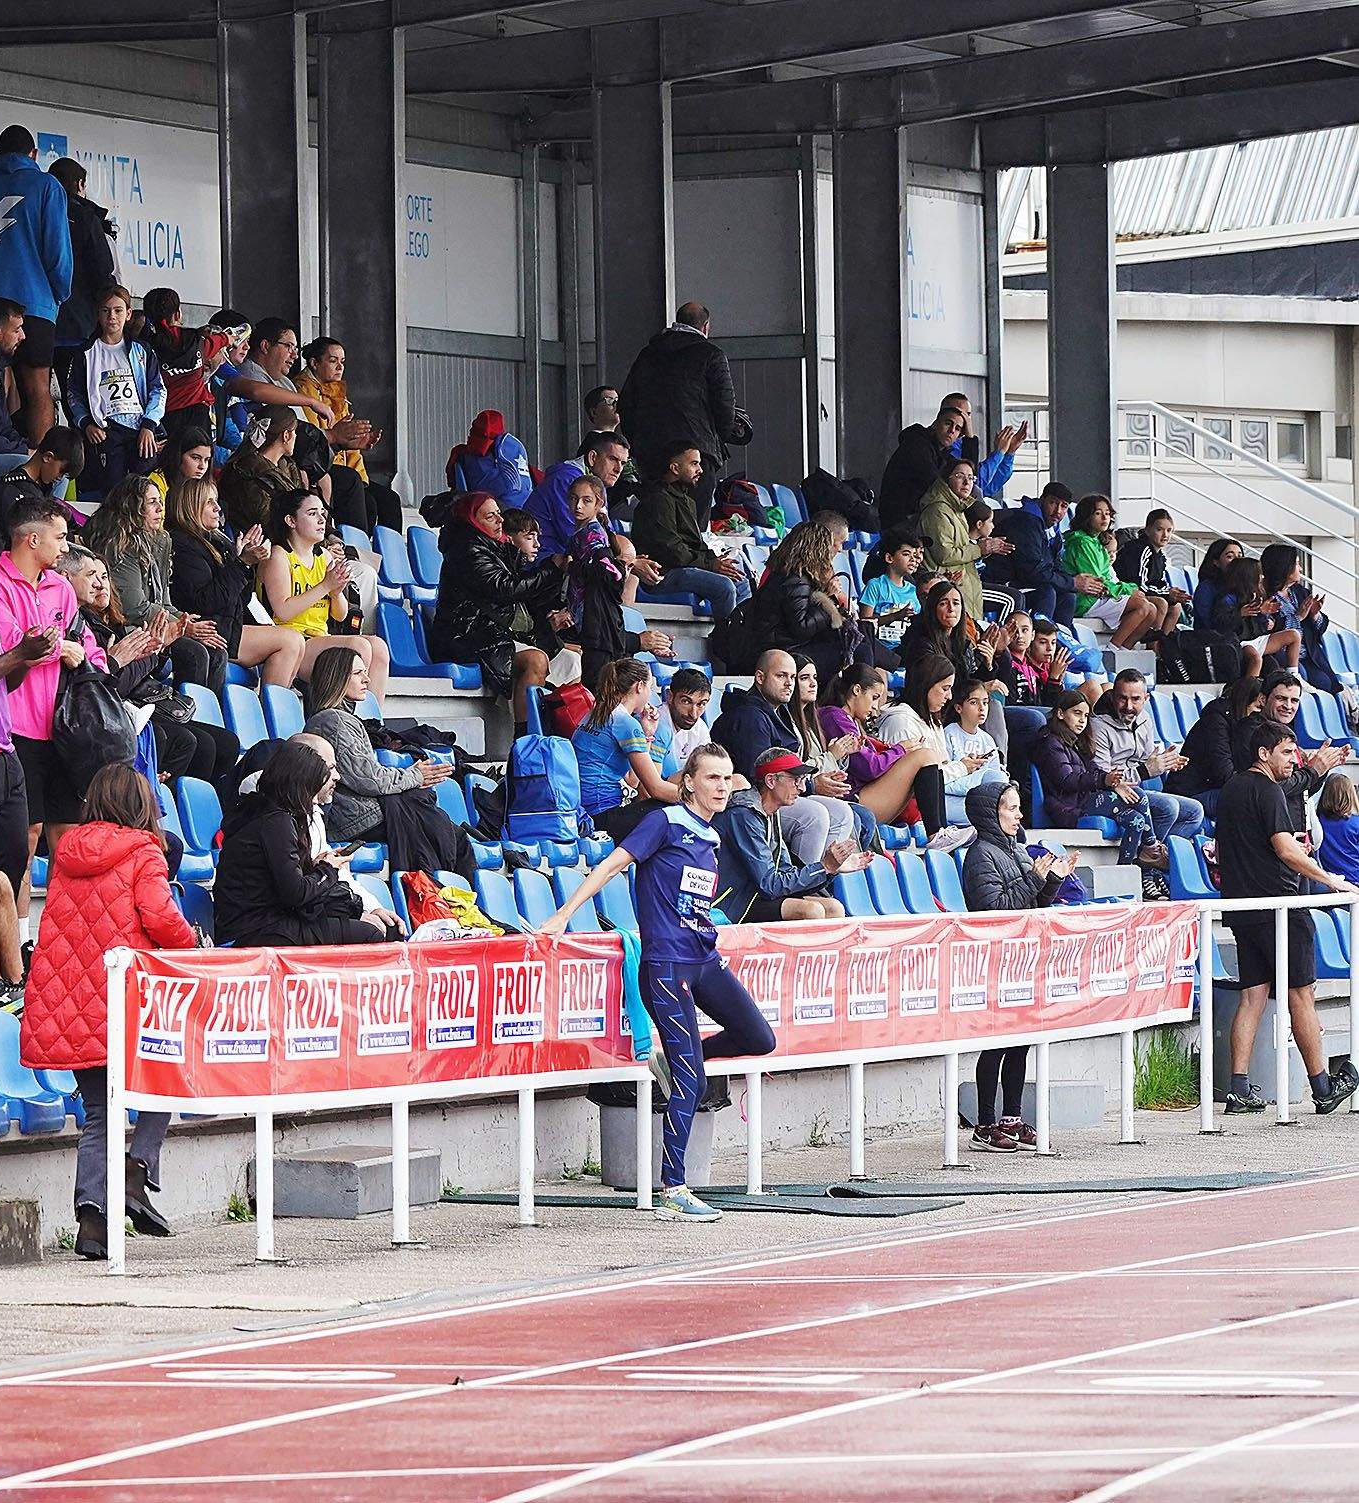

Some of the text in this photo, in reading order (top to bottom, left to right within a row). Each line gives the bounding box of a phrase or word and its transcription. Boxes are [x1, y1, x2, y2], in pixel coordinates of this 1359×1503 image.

[406, 194, 433, 223] ORTE
[120, 217, 185, 270] ALICIA
[405, 231, 430, 258] EGO
[906, 279, 946, 322] LICIA
[107, 382, 133, 401] 26
[795, 954, 838, 1000] FROIZ
[849, 950, 889, 995] FROIZ
[901, 947, 938, 991] FROIZ
[951, 943, 989, 987] FROIZ
[1000, 941, 1039, 983] FROIZ
[1048, 937, 1086, 979] FROIZ
[285, 979, 340, 1029] FROIZ
[359, 974, 411, 1025] FROIZ
[428, 970, 476, 1020] FROIZ
[496, 965, 543, 1015] FROIZ
[561, 962, 604, 1011] FROIZ
